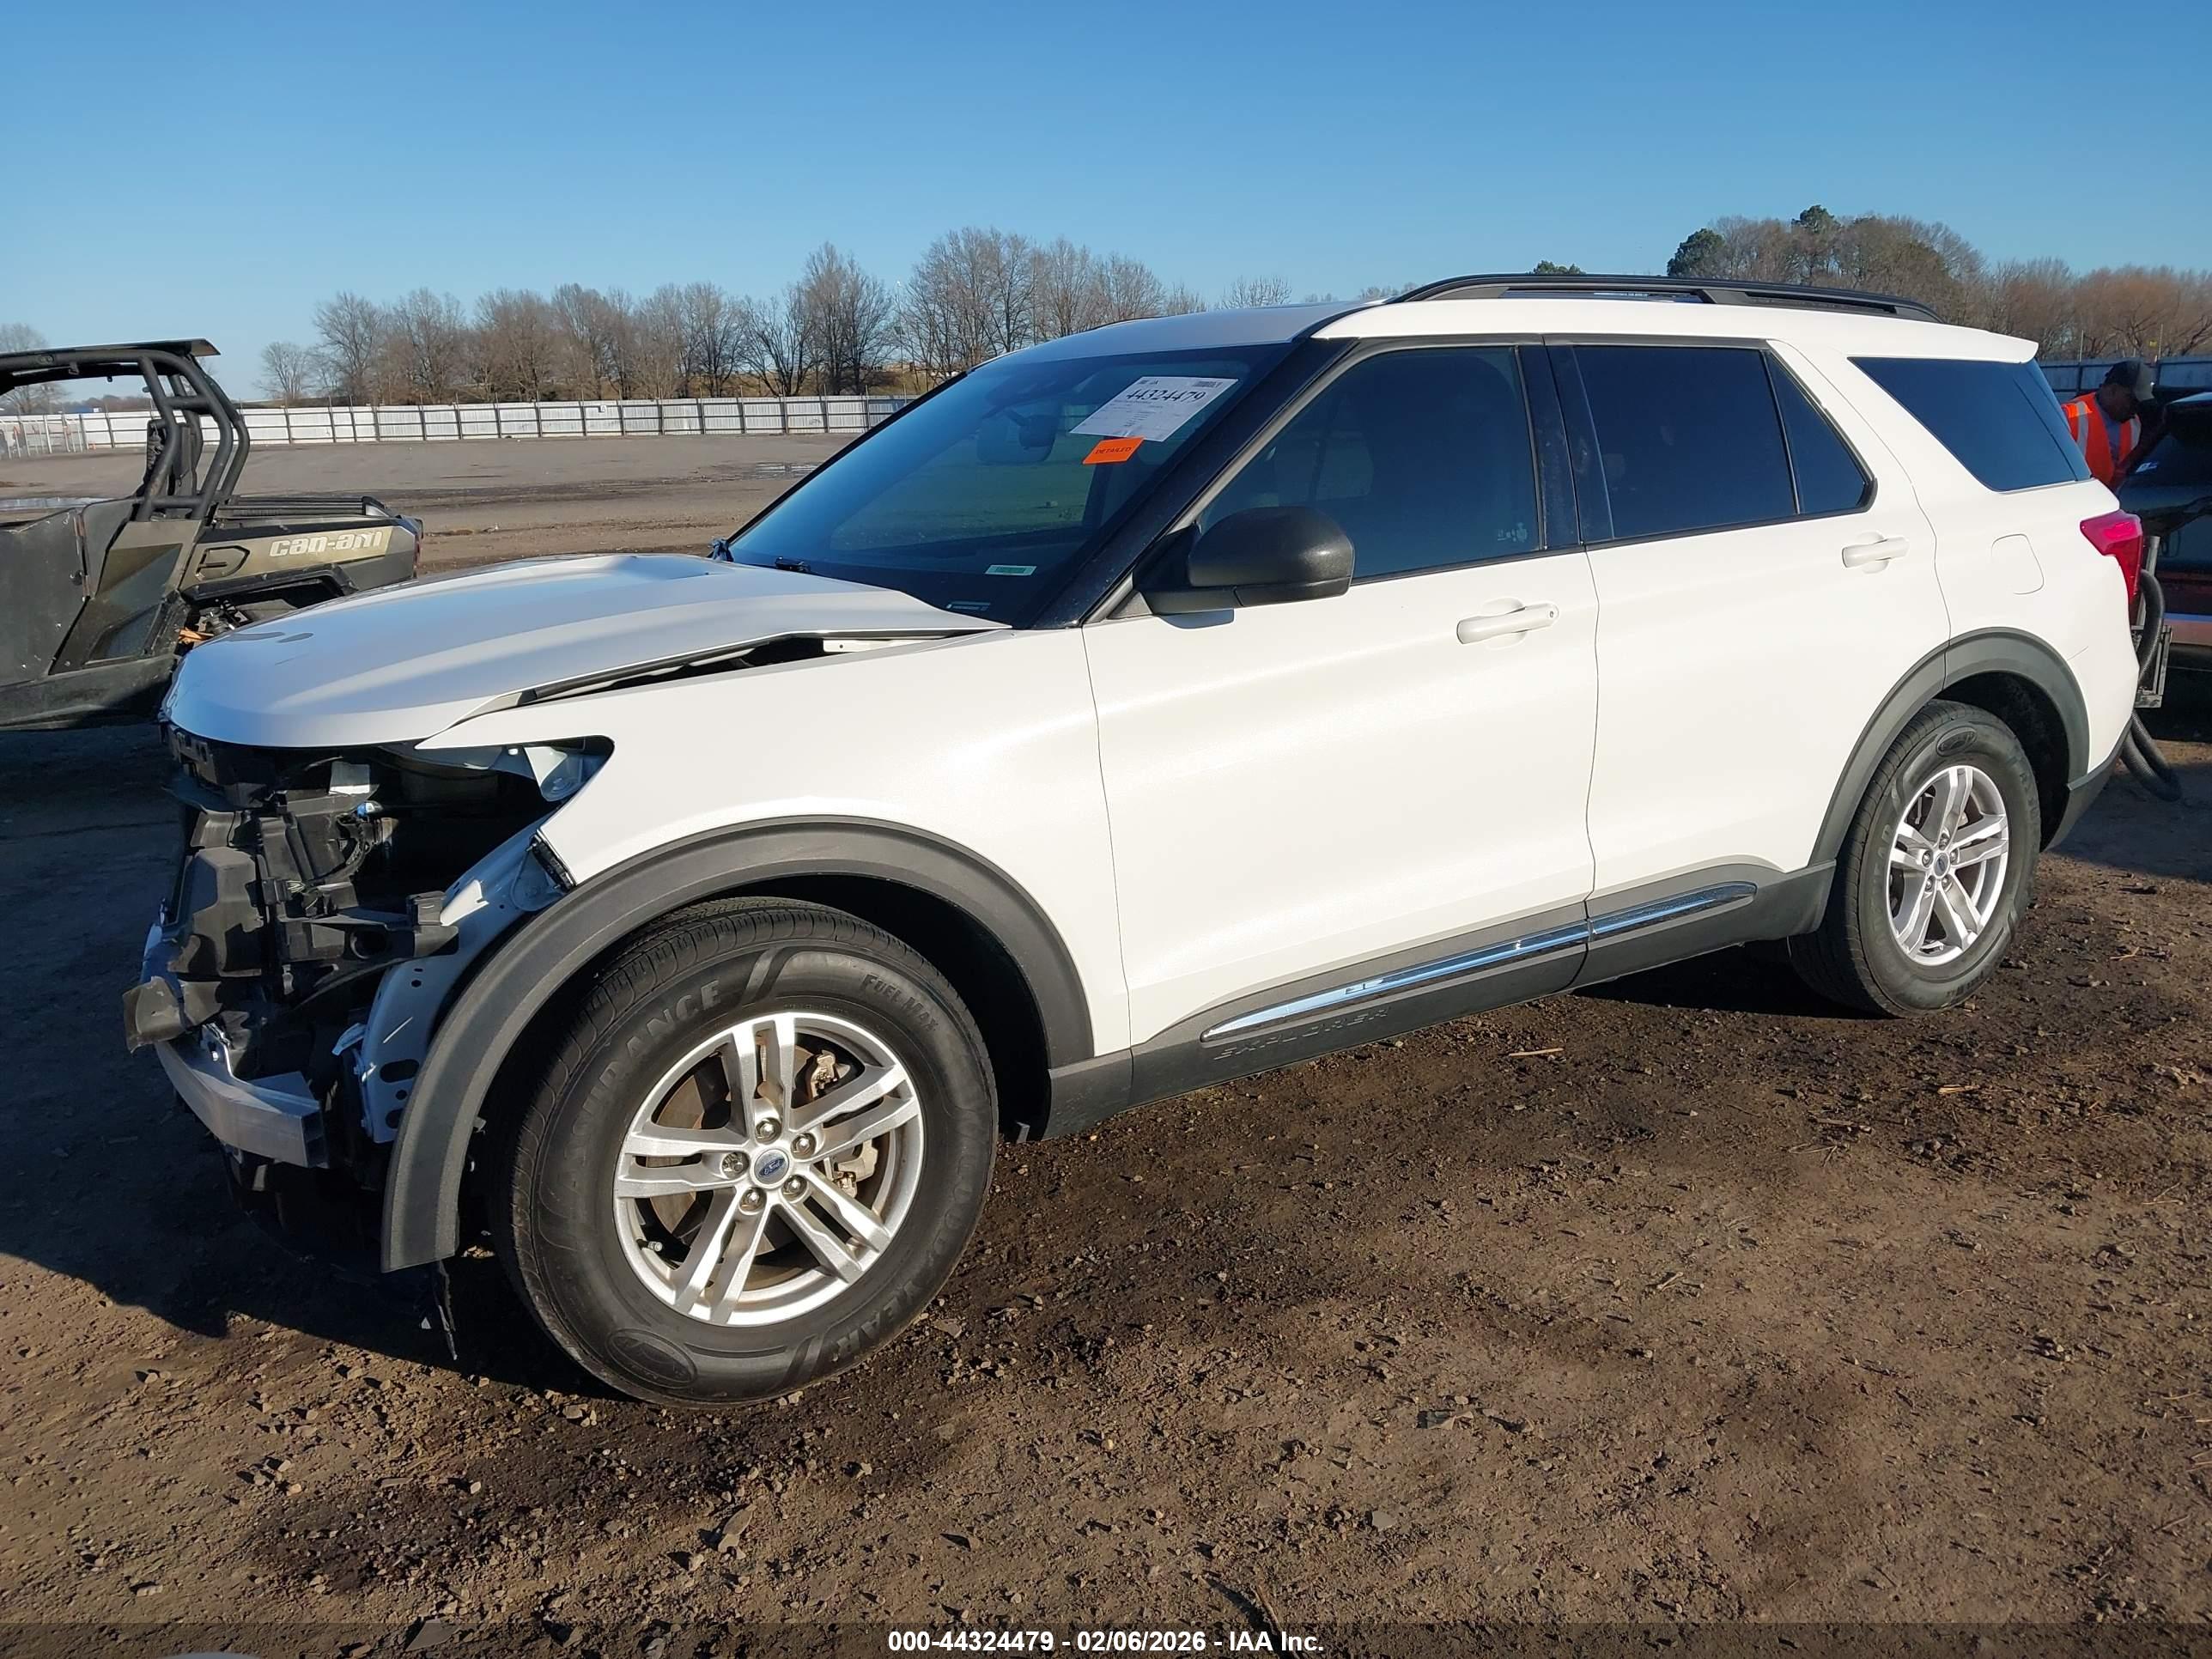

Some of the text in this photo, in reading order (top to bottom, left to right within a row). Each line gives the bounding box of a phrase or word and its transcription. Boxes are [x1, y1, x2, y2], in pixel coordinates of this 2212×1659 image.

[1127, 389, 1206, 402] 44324479
[1095, 446, 1132, 454] DETAILED
[269, 531, 384, 557] can-am
[860, 975, 939, 1031] FUEL MAX
